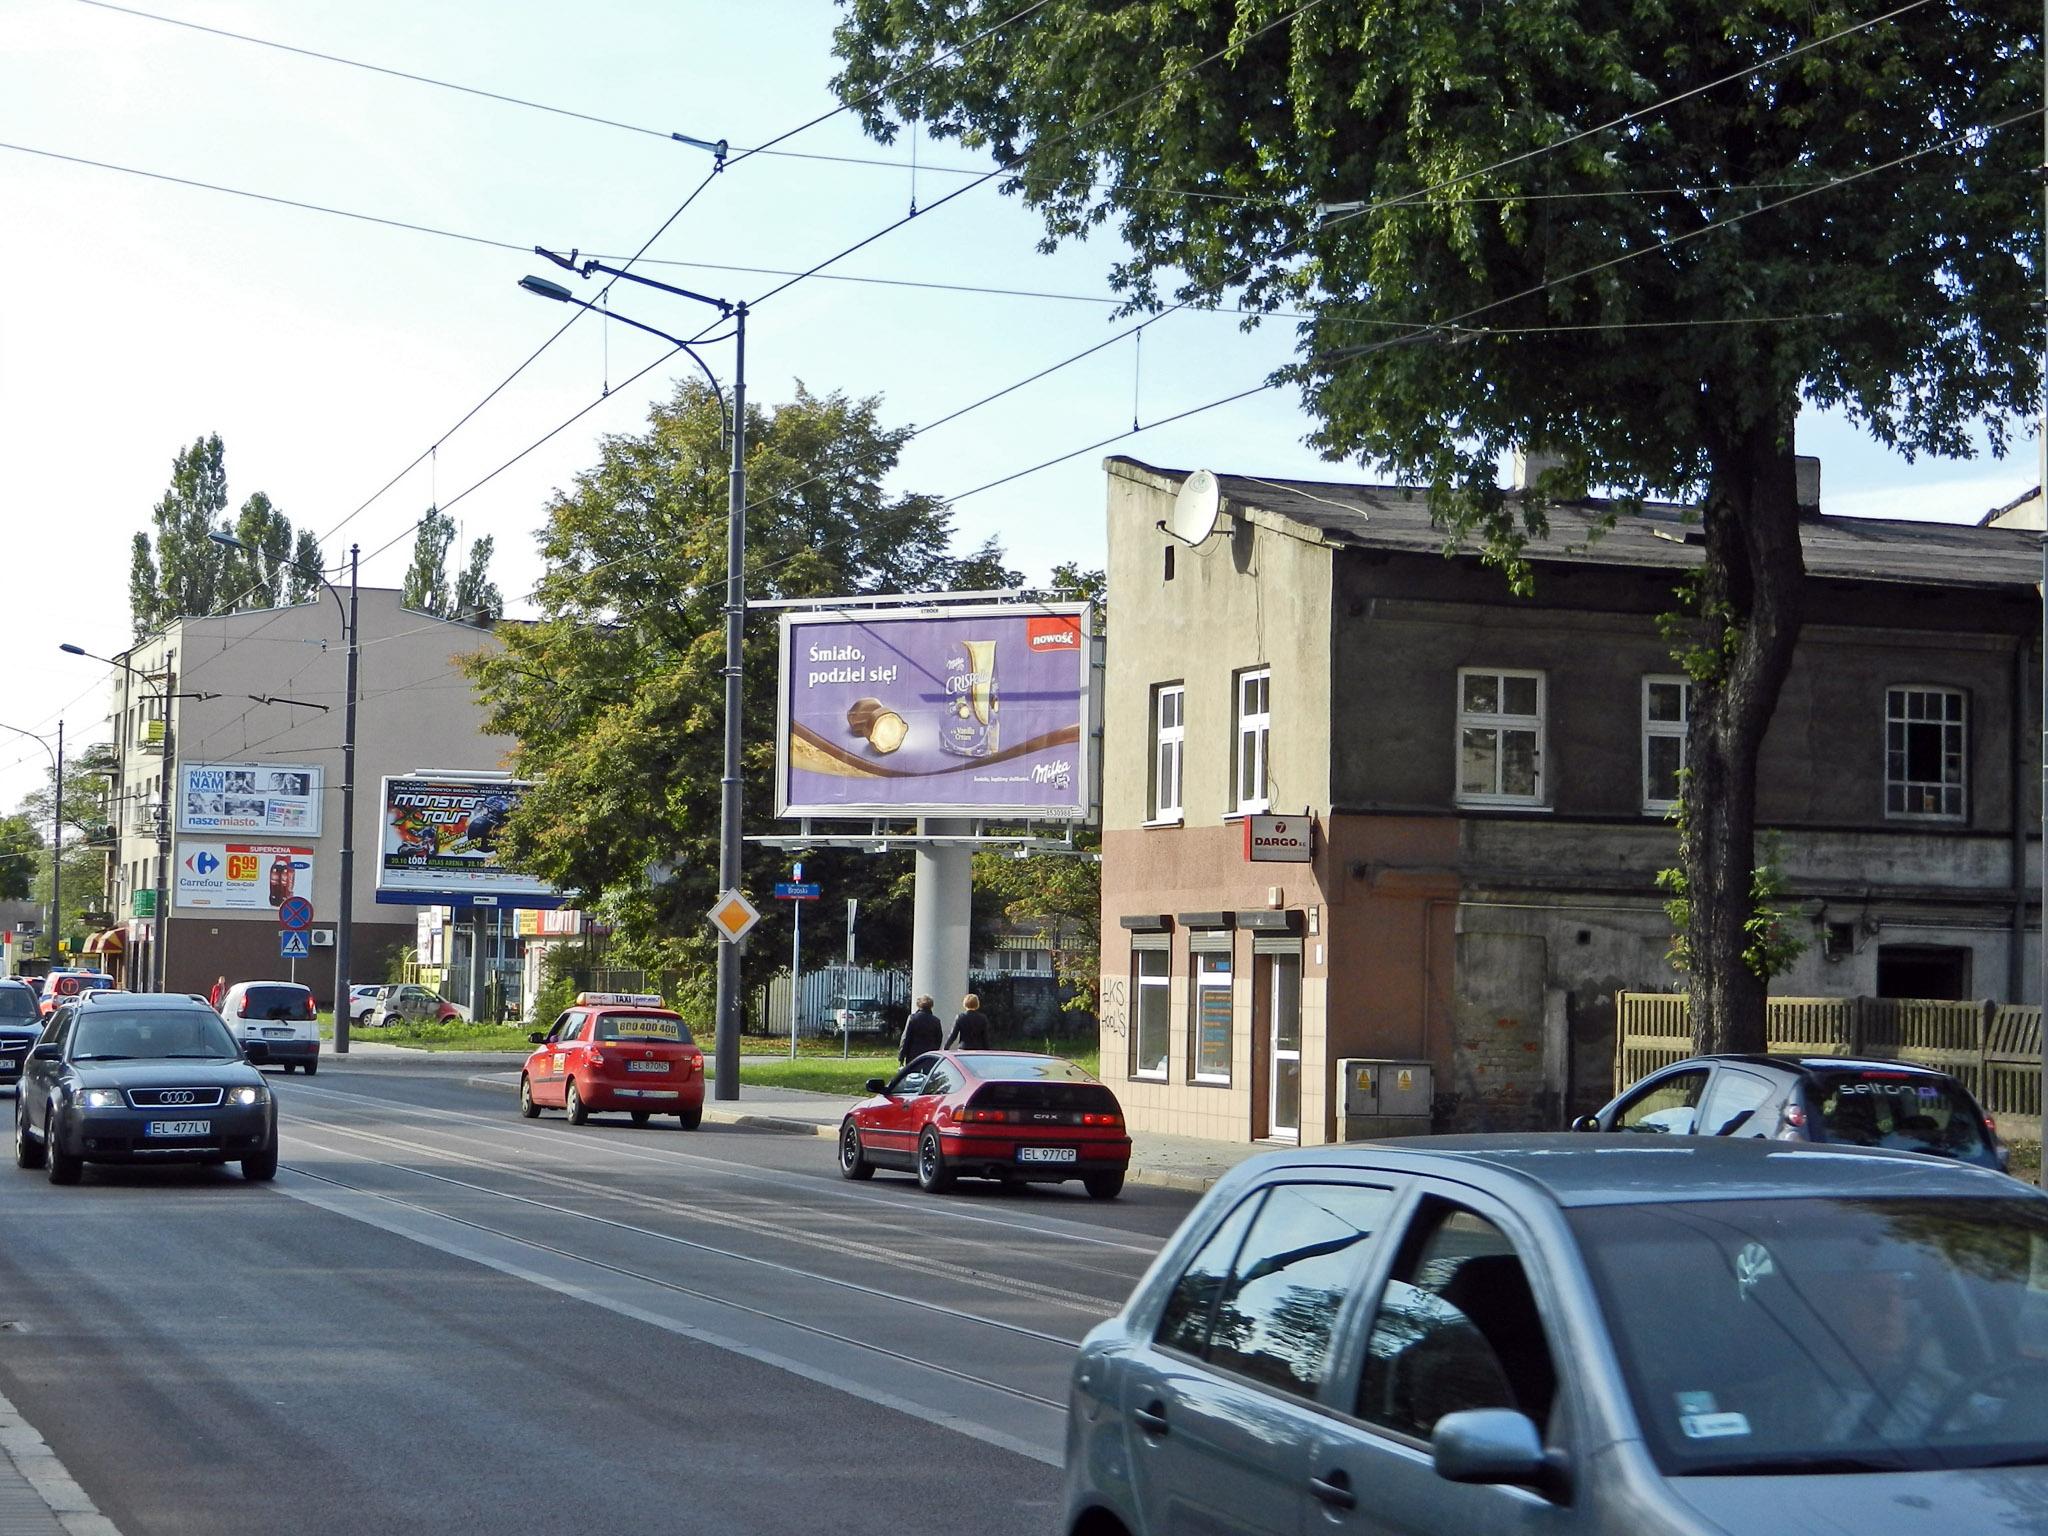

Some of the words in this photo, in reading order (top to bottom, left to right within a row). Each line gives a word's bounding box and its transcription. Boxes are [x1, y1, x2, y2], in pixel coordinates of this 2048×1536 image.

[1033, 632, 1074, 646] nowość
[808, 642, 866, 662] Śmiało,
[808, 666, 866, 688] podziel
[869, 665, 897, 685] się!
[190, 770, 225, 779] MIASTO
[1031, 760, 1071, 784] Milka
[189, 778, 224, 789] NAM
[1254, 837, 1298, 847] DARGO
[249, 845, 291, 854] SUPERCENA
[408, 855, 428, 866] ŁÓDŹ
[179, 877, 223, 888] Carrefour
[615, 995, 632, 1004] TAXI
[639, 1023, 658, 1032] 400
[658, 1024, 677, 1034] 400
[632, 1061, 643, 1070] EL
[152, 1122, 168, 1134] EL
[173, 1122, 209, 1134] 477LV
[1023, 1149, 1038, 1160] EL
[1042, 1149, 1075, 1161] 977CP
